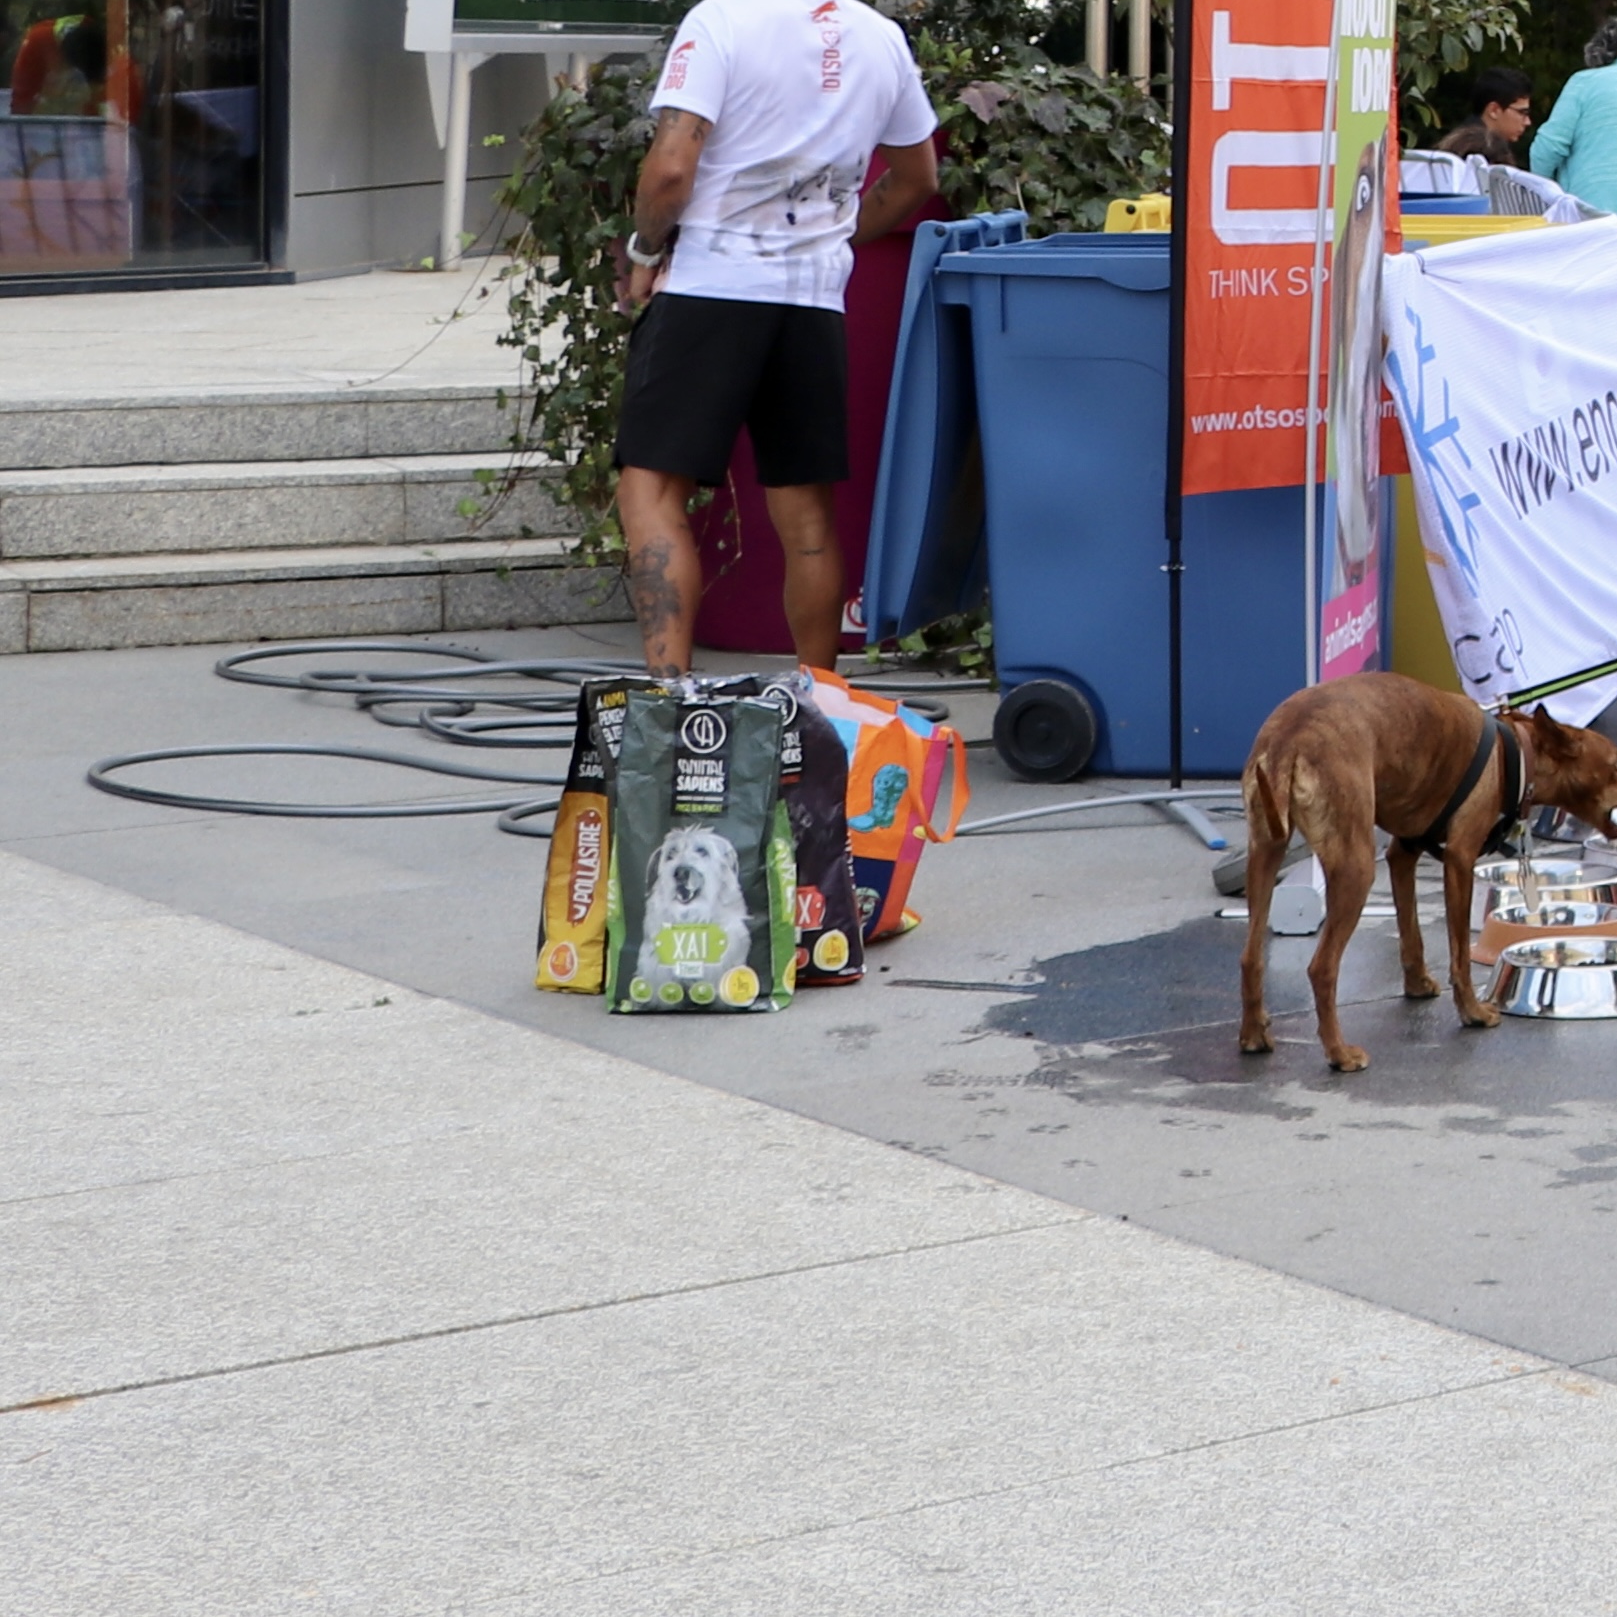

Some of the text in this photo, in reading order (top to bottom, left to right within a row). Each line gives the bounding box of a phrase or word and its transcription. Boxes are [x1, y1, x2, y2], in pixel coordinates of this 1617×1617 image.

[1208, 267, 1280, 299] THINK
[676, 775, 725, 793] SAPIENS
[672, 931, 708, 960] XAI
